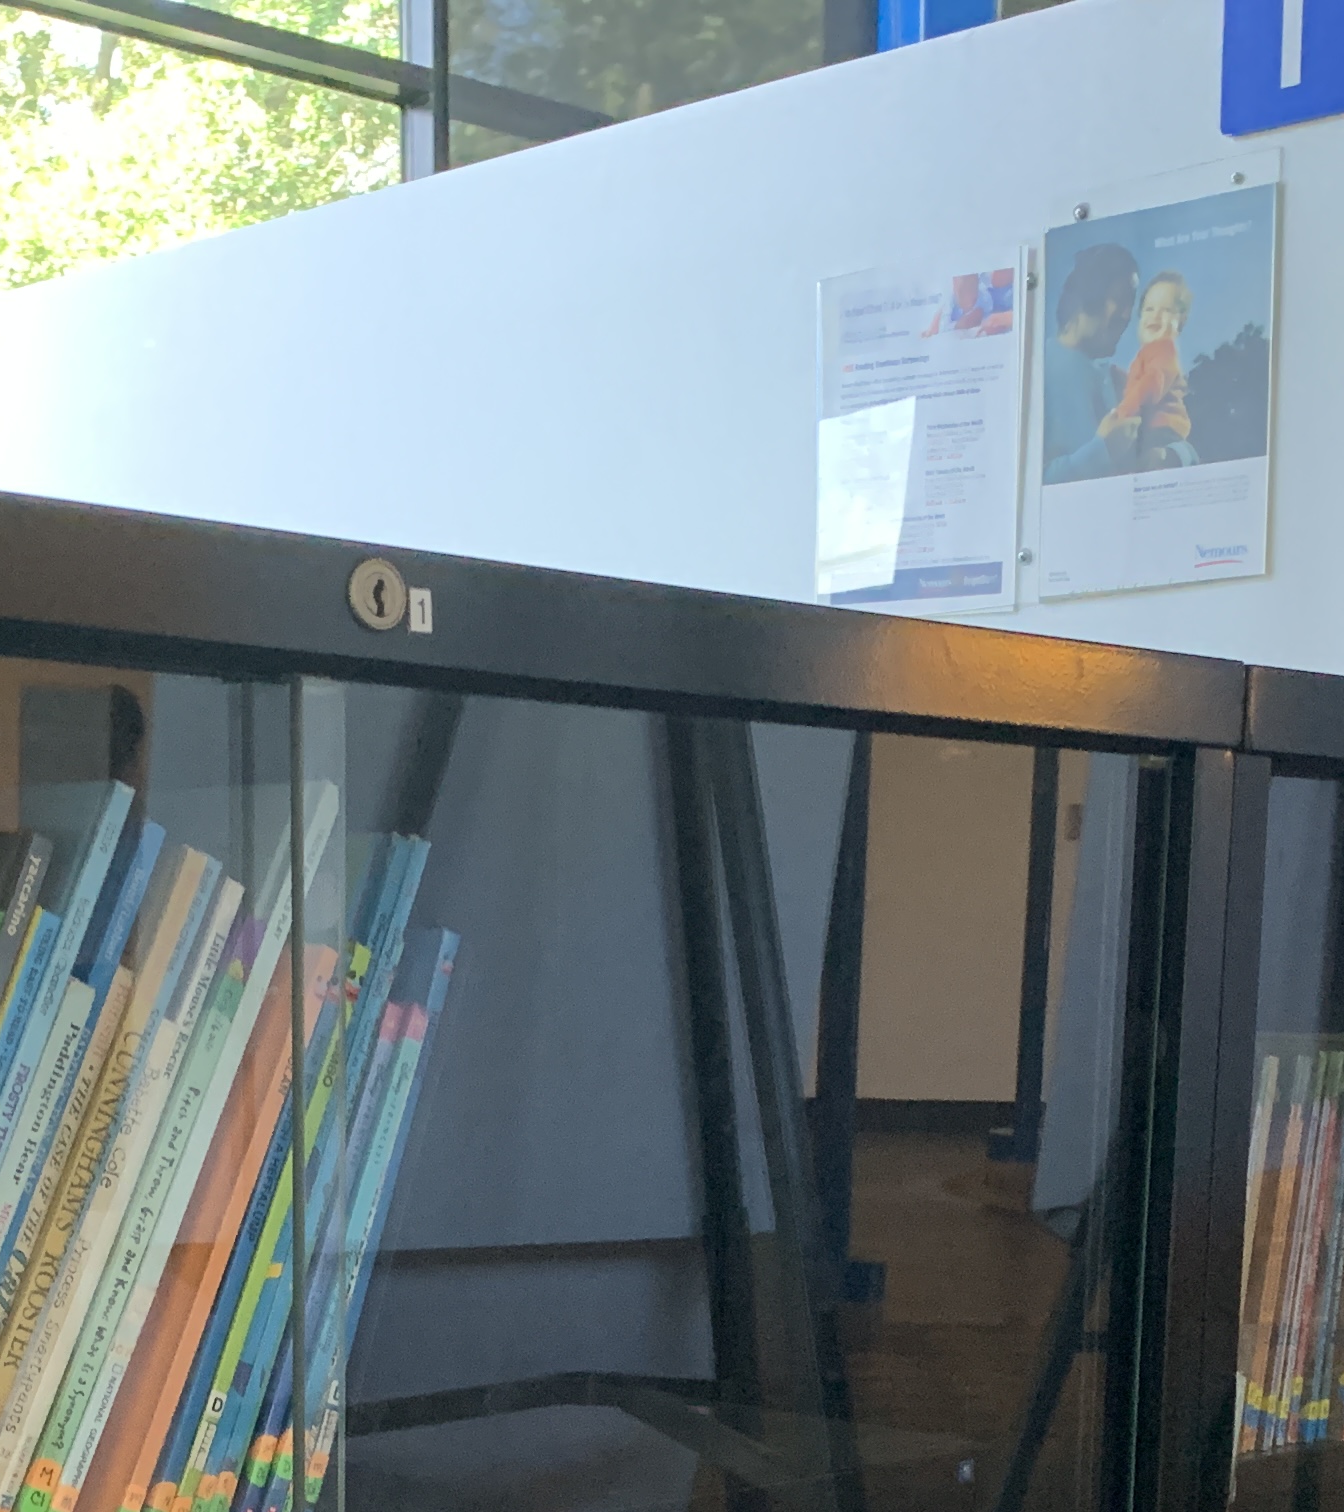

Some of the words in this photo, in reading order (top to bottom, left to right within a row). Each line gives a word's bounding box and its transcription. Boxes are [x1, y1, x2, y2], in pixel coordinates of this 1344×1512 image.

[1195, 544, 1248, 559] Nemours
[418, 598, 425, 625] 1
[7, 1062, 32, 1124] FROSTY
[27, 1021, 81, 1136] Paddington
[119, 1067, 161, 1137] Babette
[12, 1136, 38, 1187] Bear
[99, 1145, 128, 1190] Cole
[53, 1237, 92, 1310] Princess
